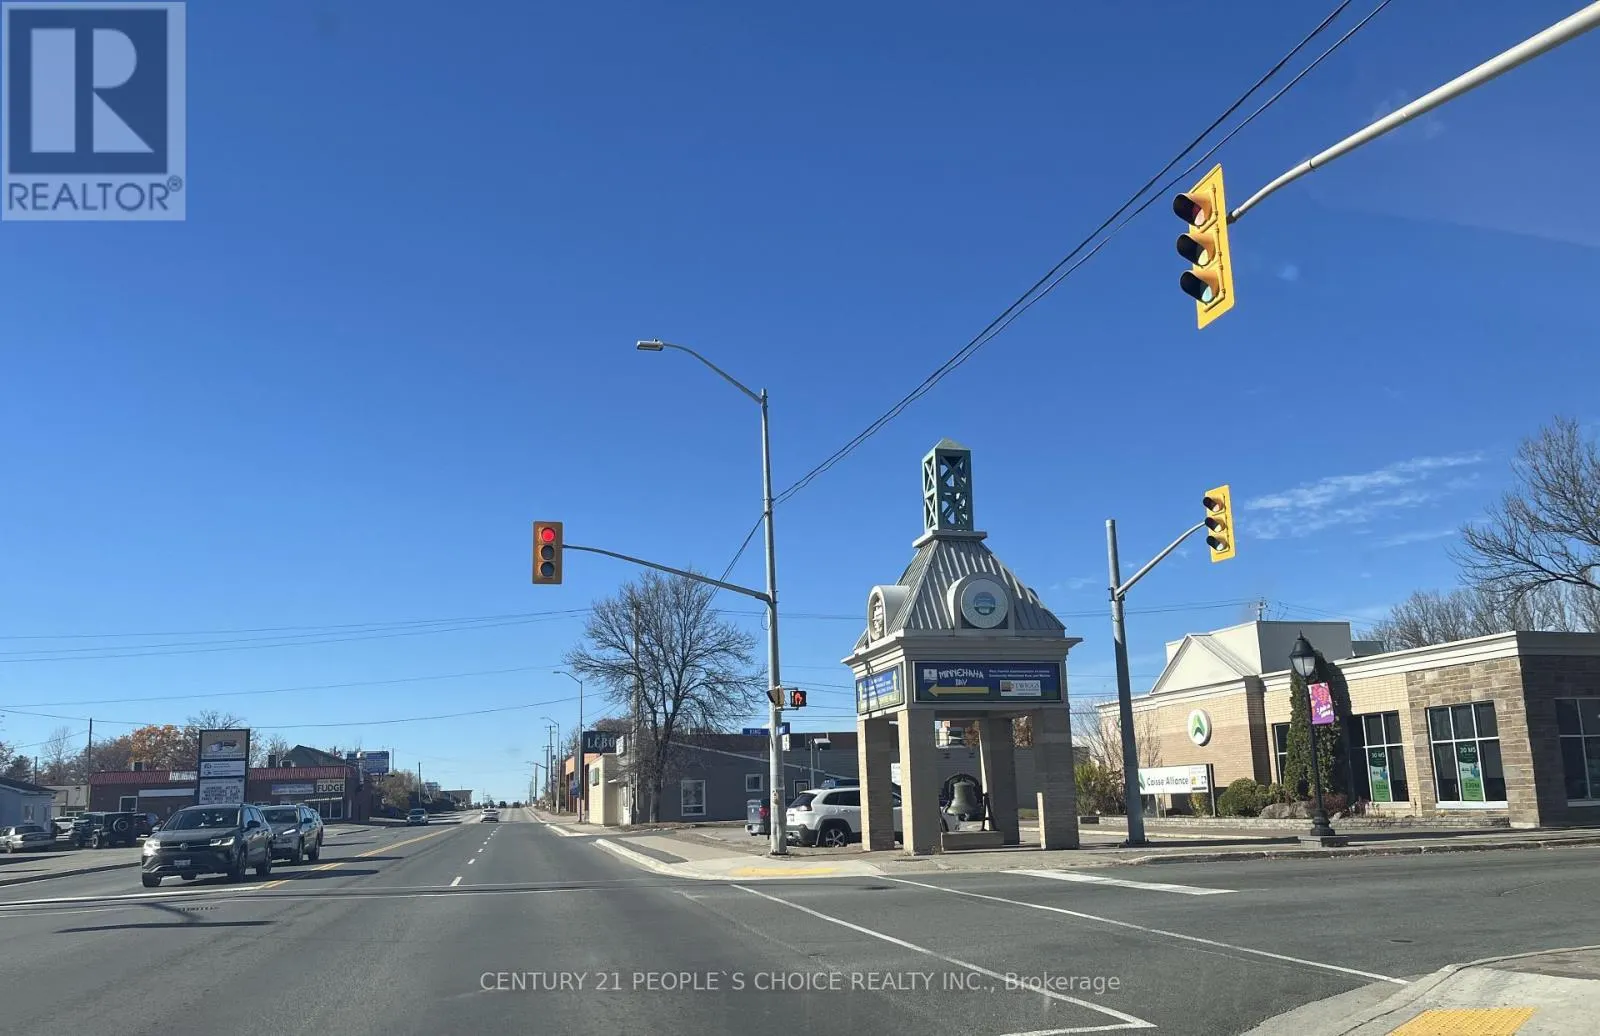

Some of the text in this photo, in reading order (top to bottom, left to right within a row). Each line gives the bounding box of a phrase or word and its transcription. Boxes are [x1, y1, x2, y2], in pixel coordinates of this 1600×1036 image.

[1146, 776, 1189, 786] Caisse Alliance
[316, 783, 345, 793] FUDGE
